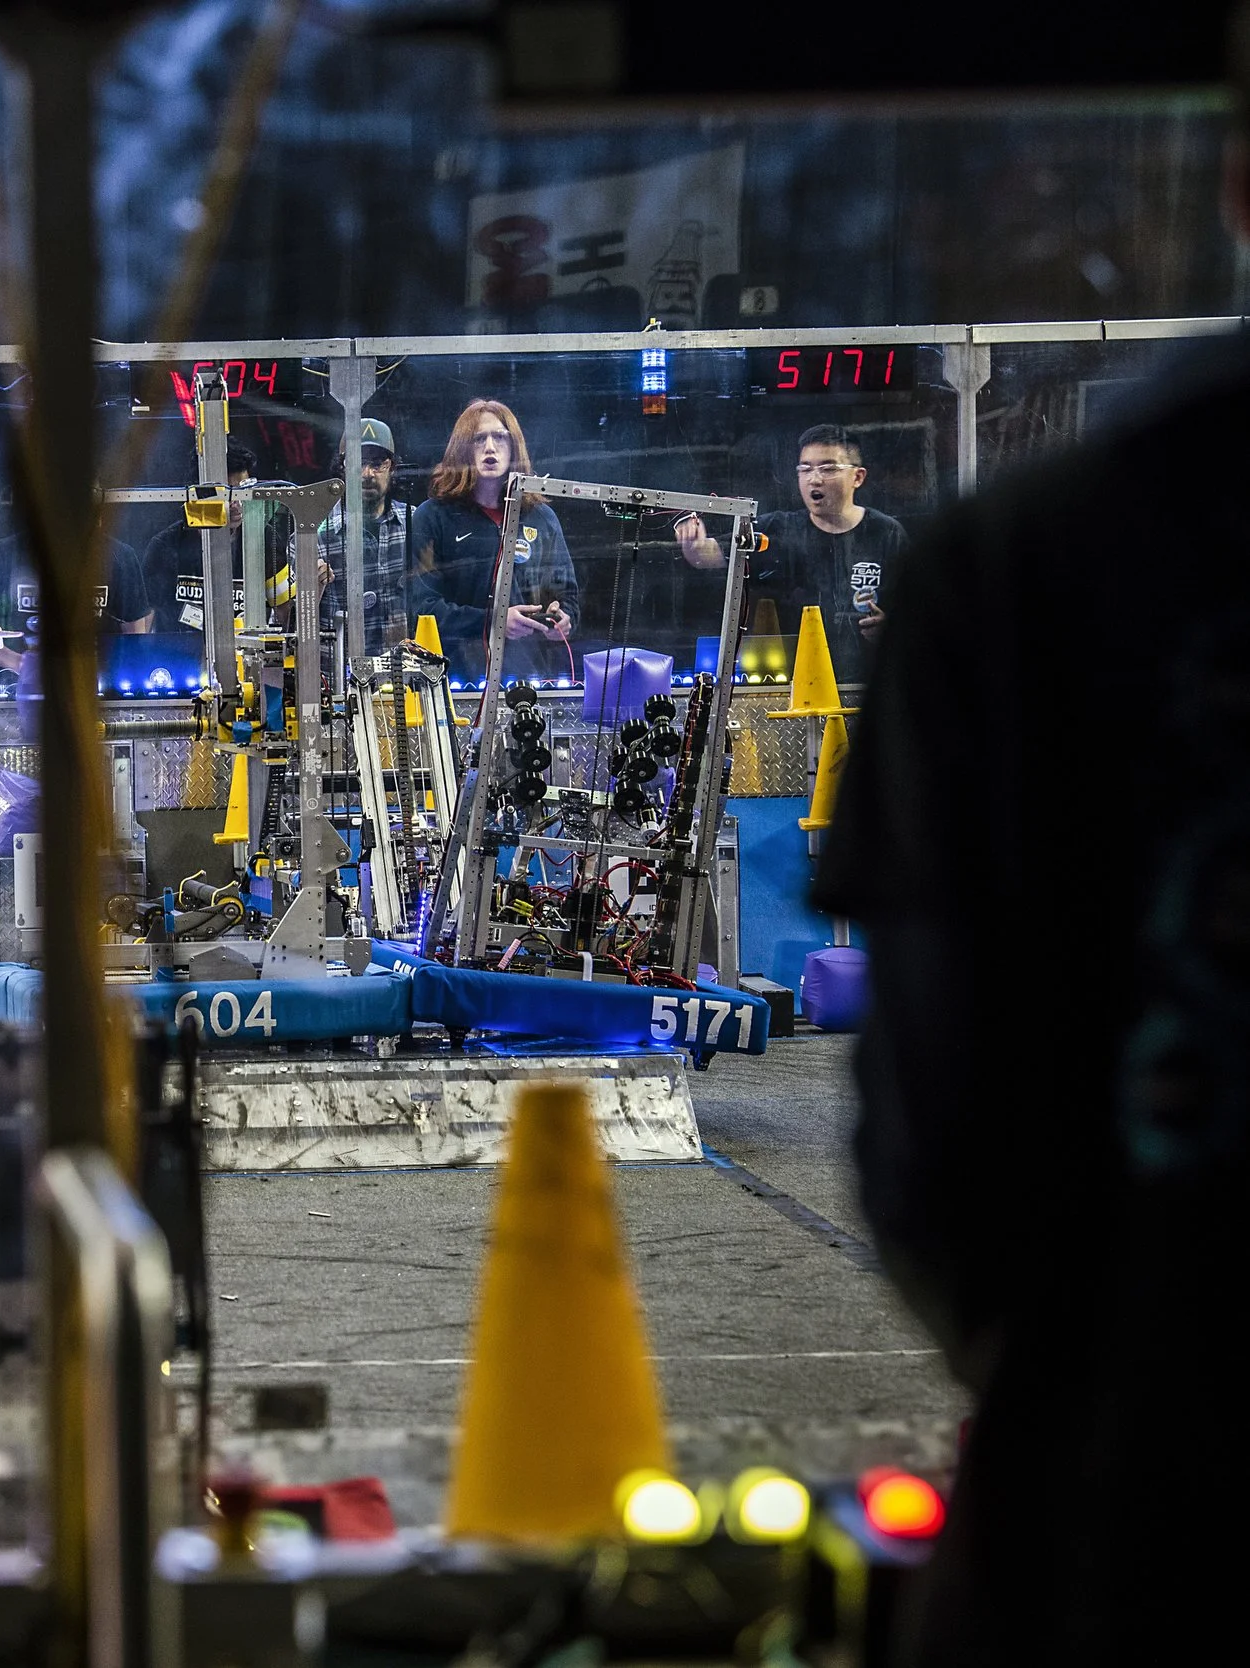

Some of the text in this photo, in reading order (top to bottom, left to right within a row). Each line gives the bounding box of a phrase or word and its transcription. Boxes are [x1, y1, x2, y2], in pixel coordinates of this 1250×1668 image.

[777, 350, 895, 389] 5171
[850, 574, 880, 585] 5171
[852, 567, 881, 575] TEAM
[174, 991, 277, 1038] 604
[651, 996, 753, 1049] 5171
